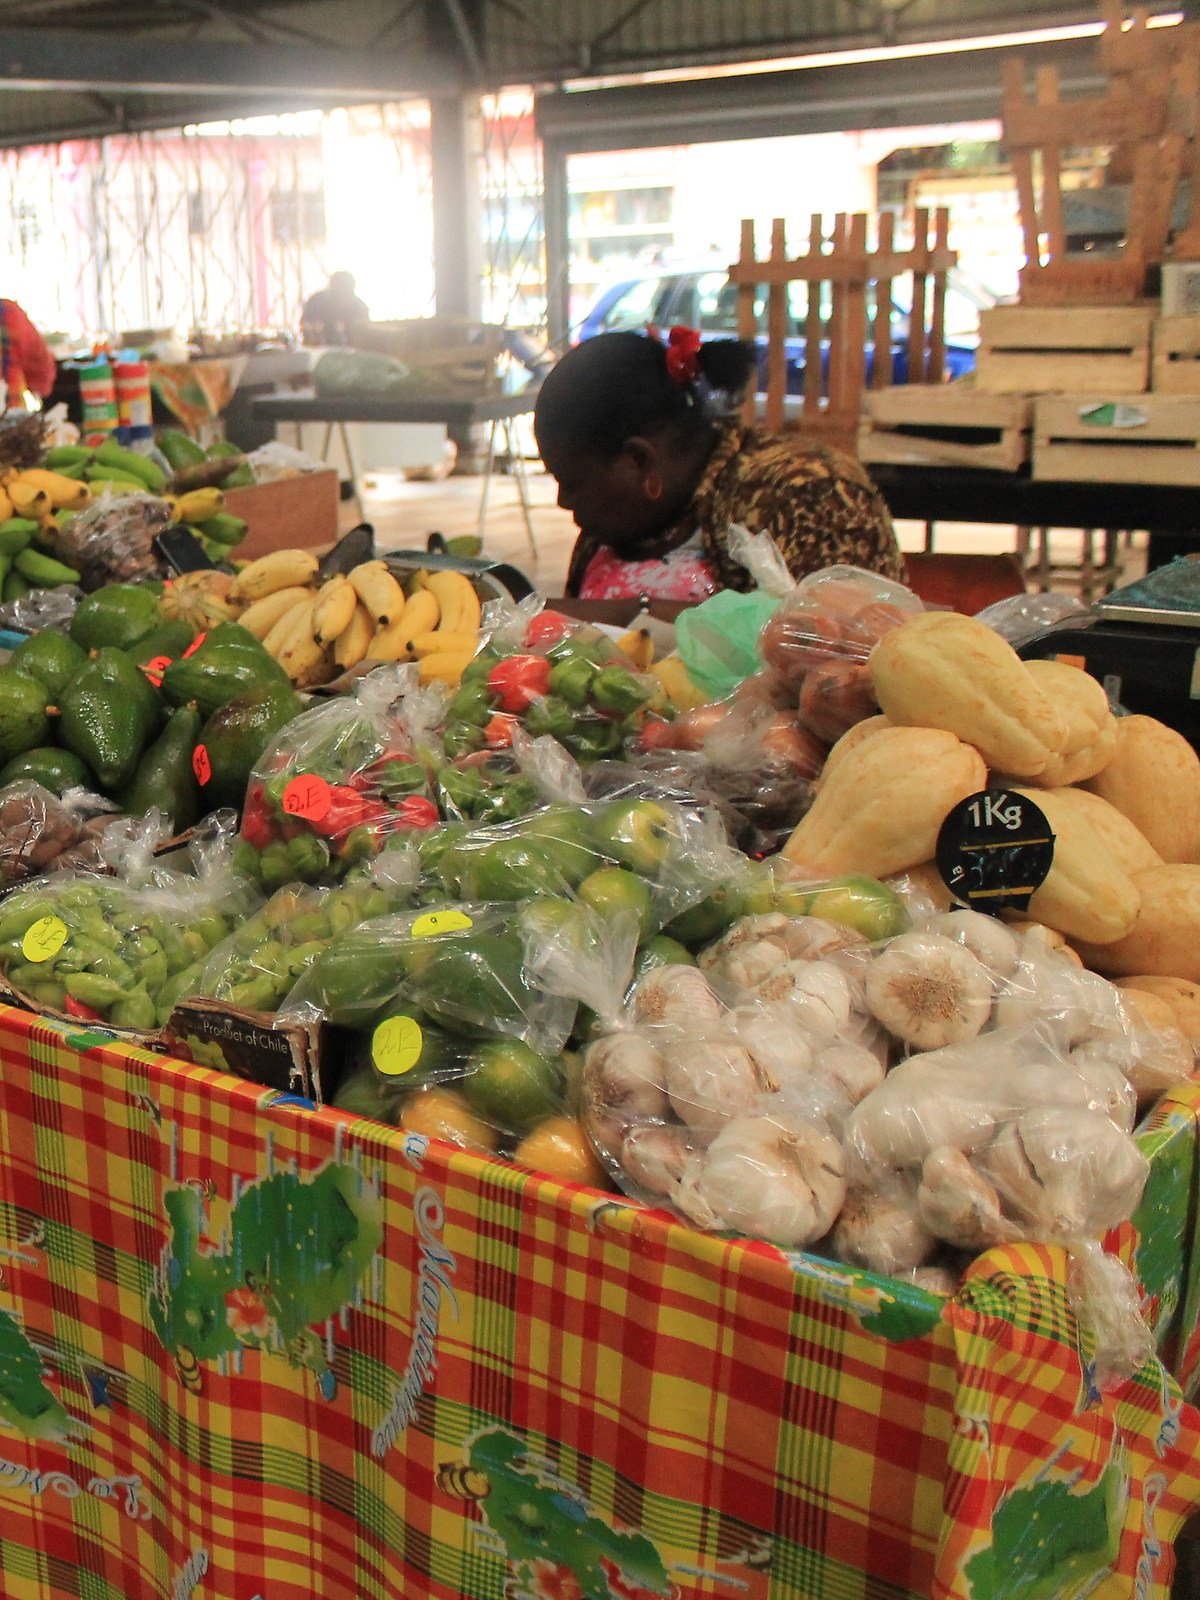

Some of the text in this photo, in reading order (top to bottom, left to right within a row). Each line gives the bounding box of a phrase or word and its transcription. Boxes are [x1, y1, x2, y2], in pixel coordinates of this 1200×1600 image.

[968, 794, 1022, 830] 1Kg
[203, 1020, 288, 1054] Product of Chile
